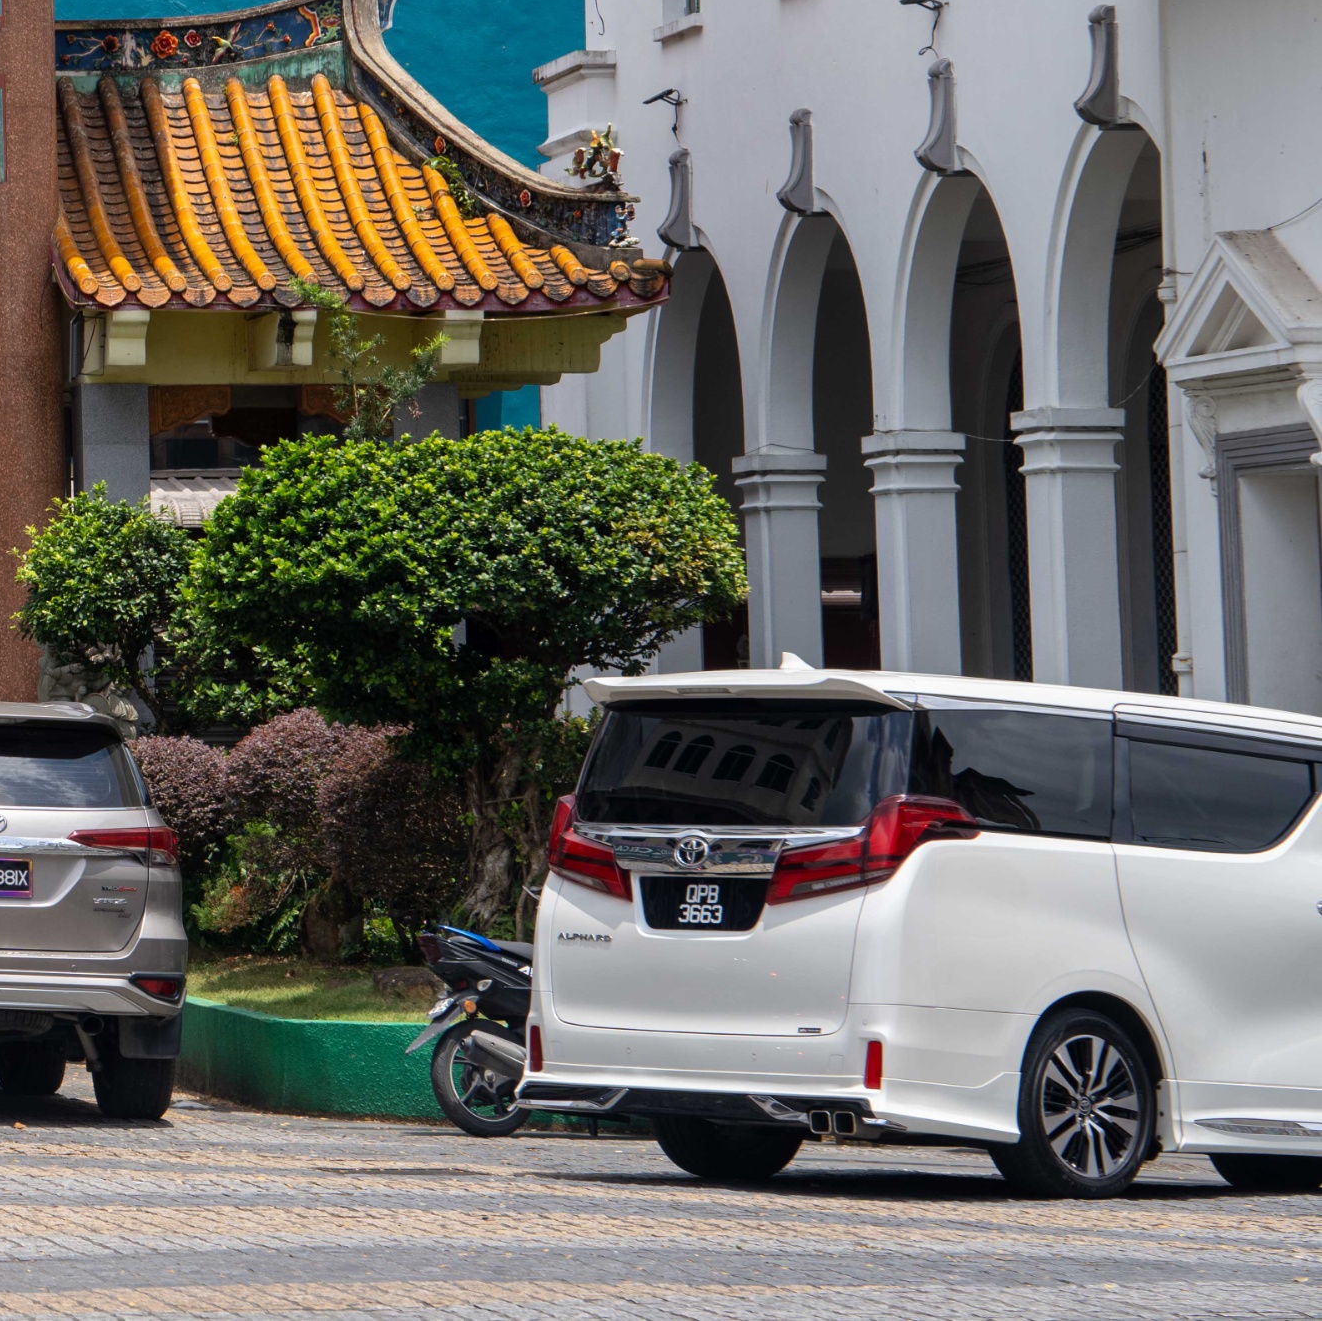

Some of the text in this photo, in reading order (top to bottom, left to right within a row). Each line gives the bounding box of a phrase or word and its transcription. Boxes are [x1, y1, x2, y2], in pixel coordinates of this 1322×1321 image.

[686, 884, 719, 904] QPB
[678, 905, 723, 924] 3663
[557, 932, 613, 942] ALPHARD
